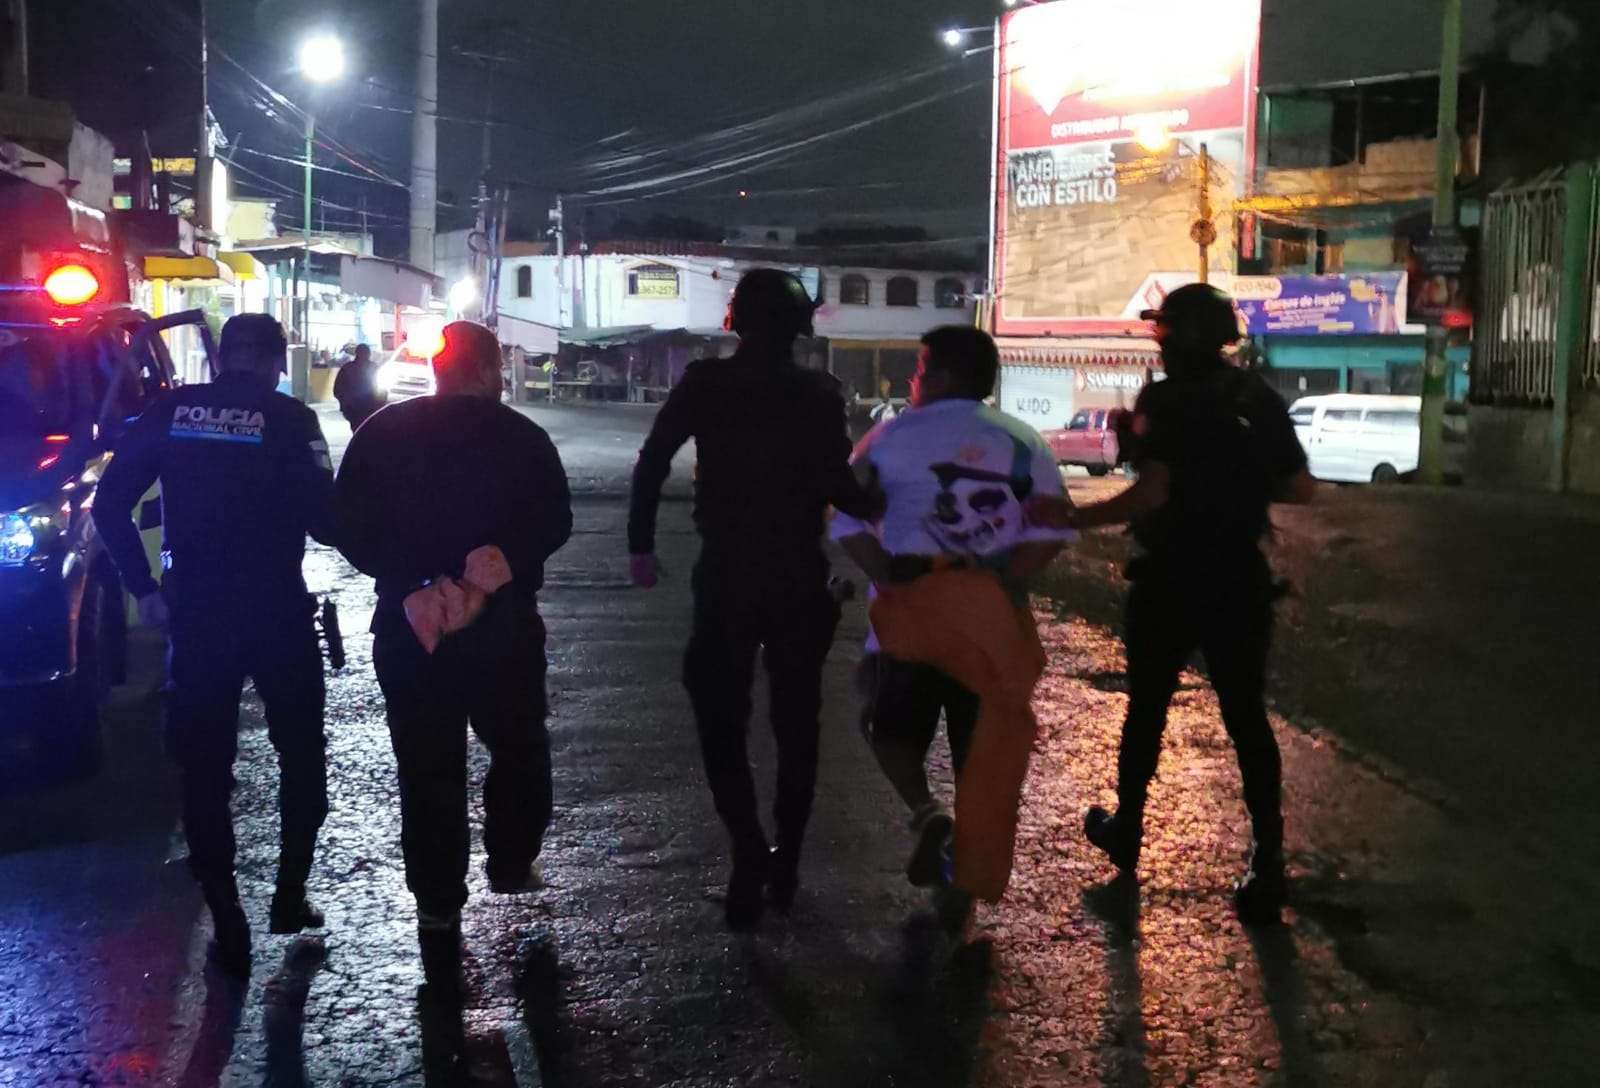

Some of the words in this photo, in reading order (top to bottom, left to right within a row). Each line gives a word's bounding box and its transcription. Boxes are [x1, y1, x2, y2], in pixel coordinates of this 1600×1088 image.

[1016, 183, 1051, 208] CON
[1055, 177, 1117, 205] ESTILO
[173, 405, 265, 427] POLICIA
